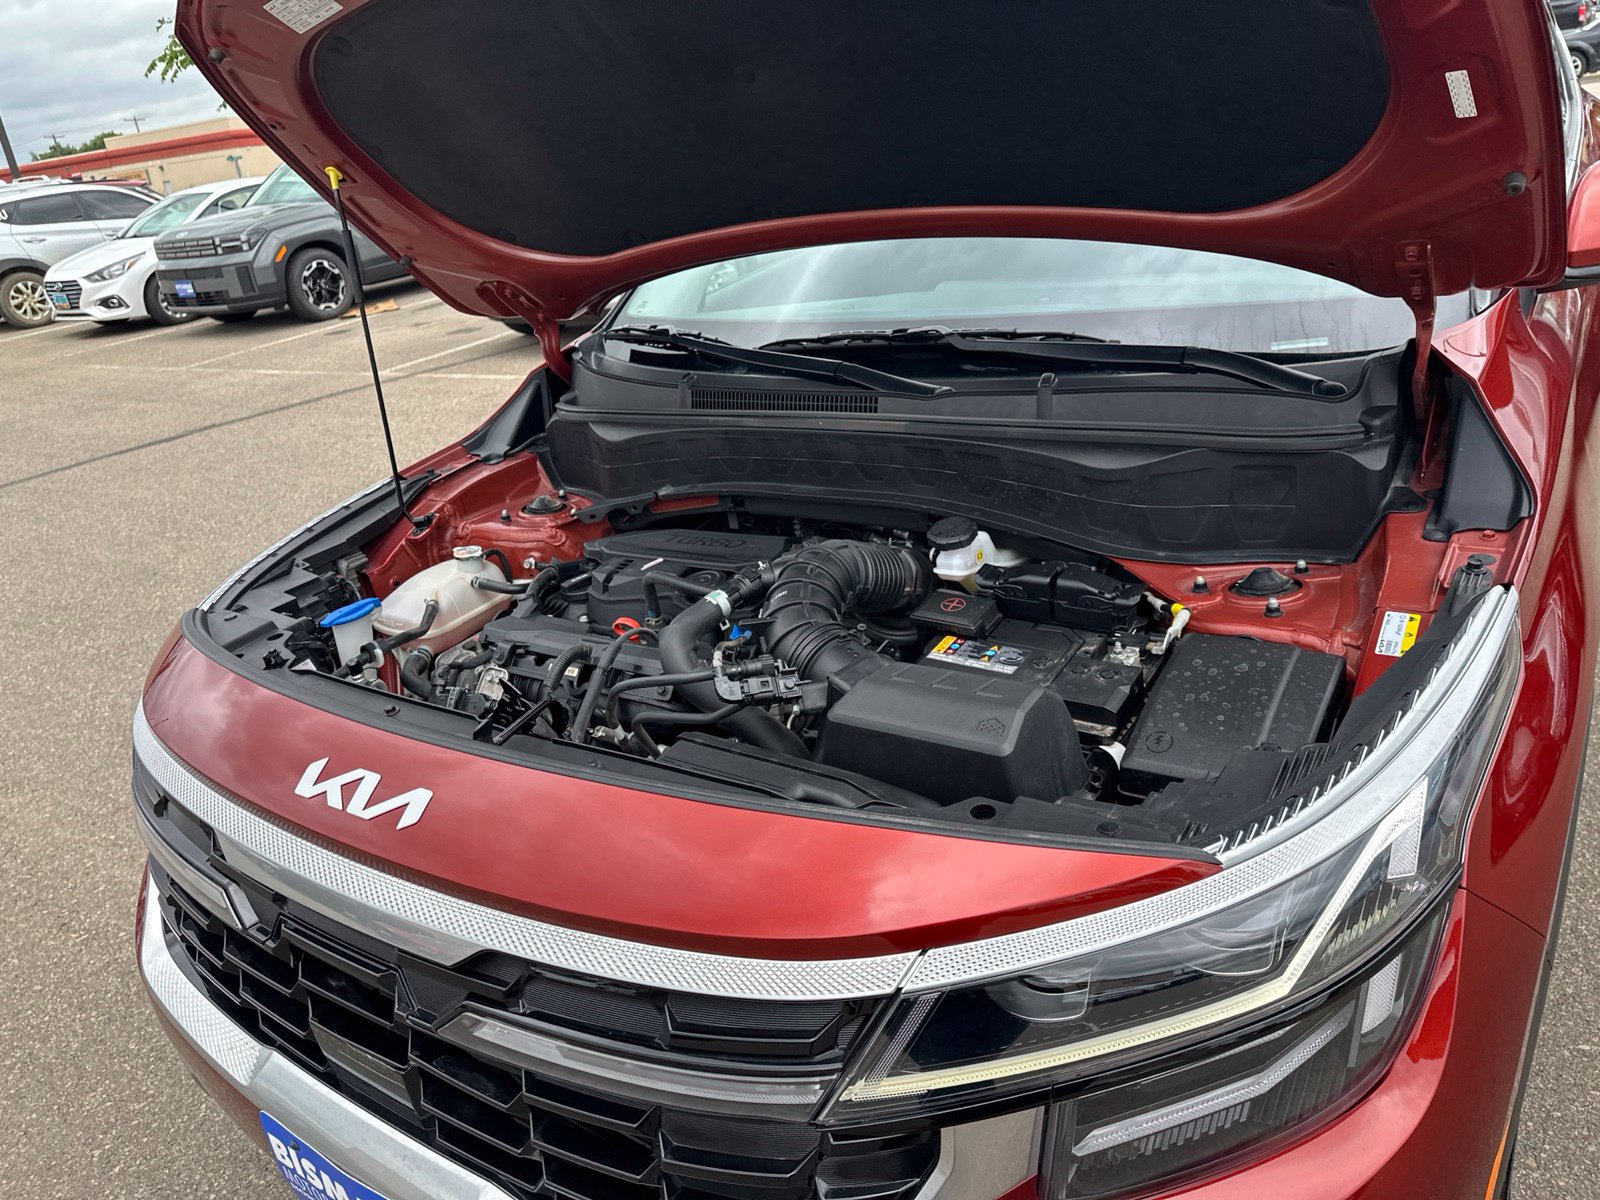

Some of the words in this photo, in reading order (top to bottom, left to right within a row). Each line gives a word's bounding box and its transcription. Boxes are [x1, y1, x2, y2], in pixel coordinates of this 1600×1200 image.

[666, 534, 746, 549] TURBO
[294, 757, 434, 830] KIA
[267, 1132, 361, 1200] BISM
